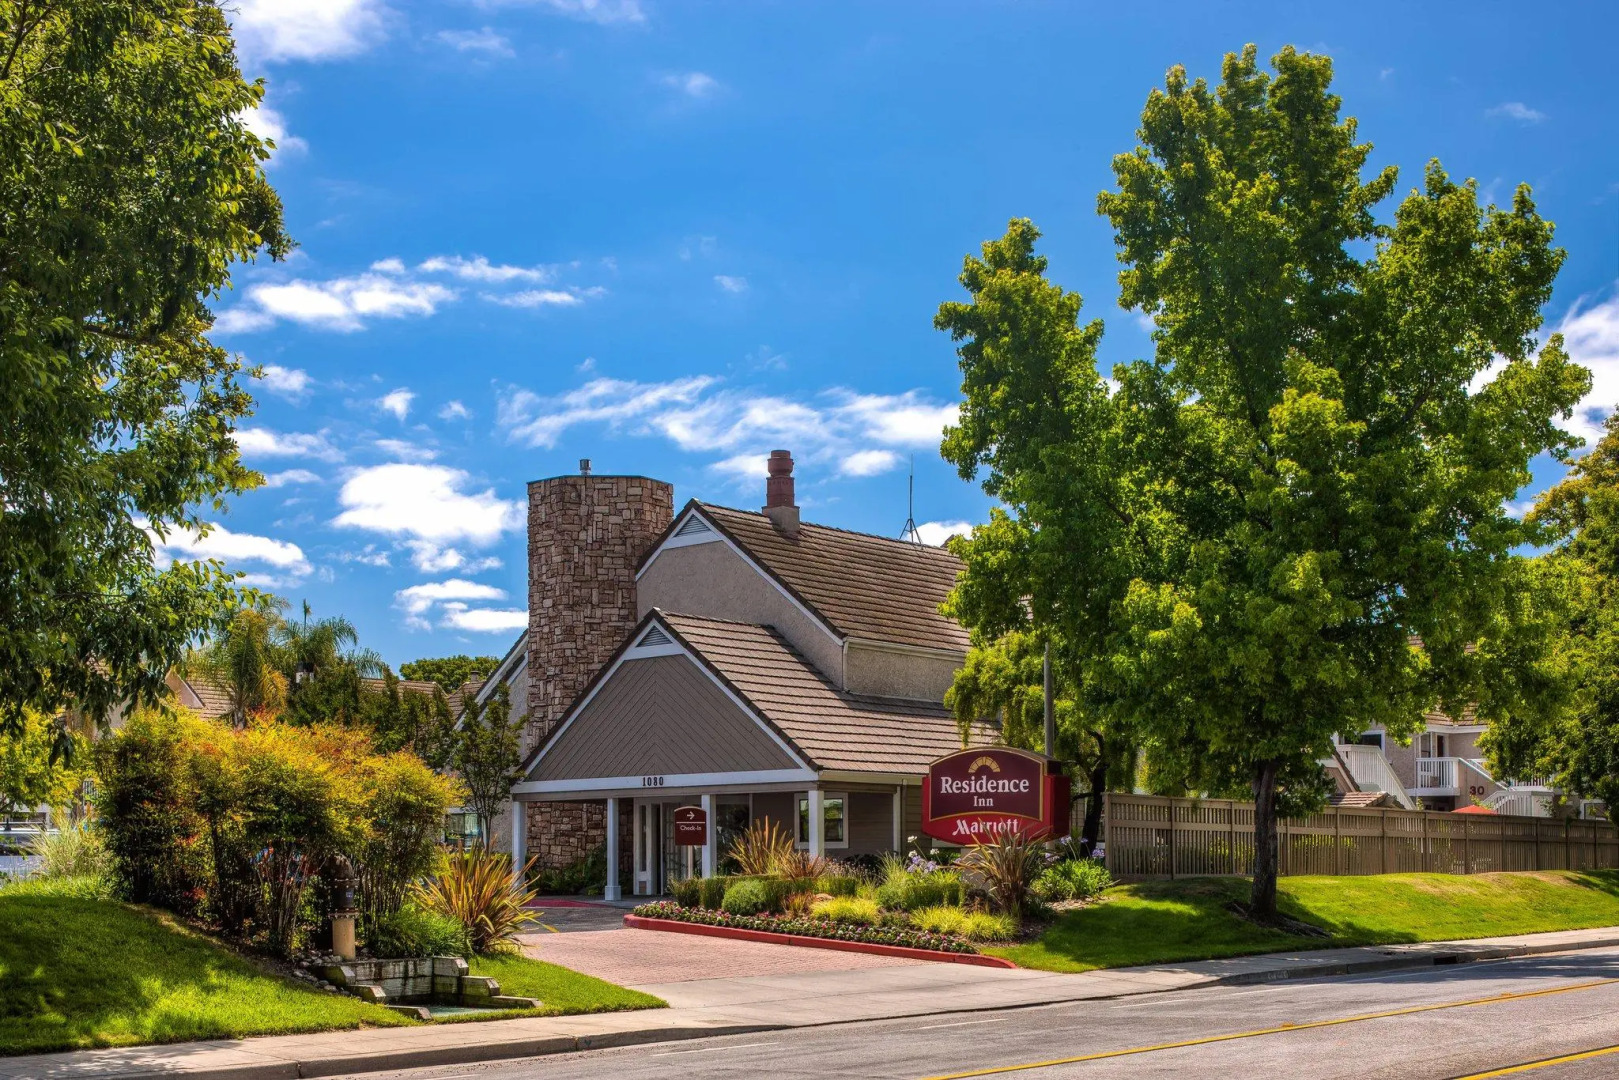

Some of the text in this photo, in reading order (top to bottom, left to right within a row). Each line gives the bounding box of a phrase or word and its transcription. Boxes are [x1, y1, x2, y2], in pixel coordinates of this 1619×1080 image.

[642, 776, 664, 787] 1080
[940, 775, 1029, 794] Residence
[1469, 785, 1485, 795] 30
[973, 795, 994, 807] Inn
[952, 819, 1018, 836] Marriott
